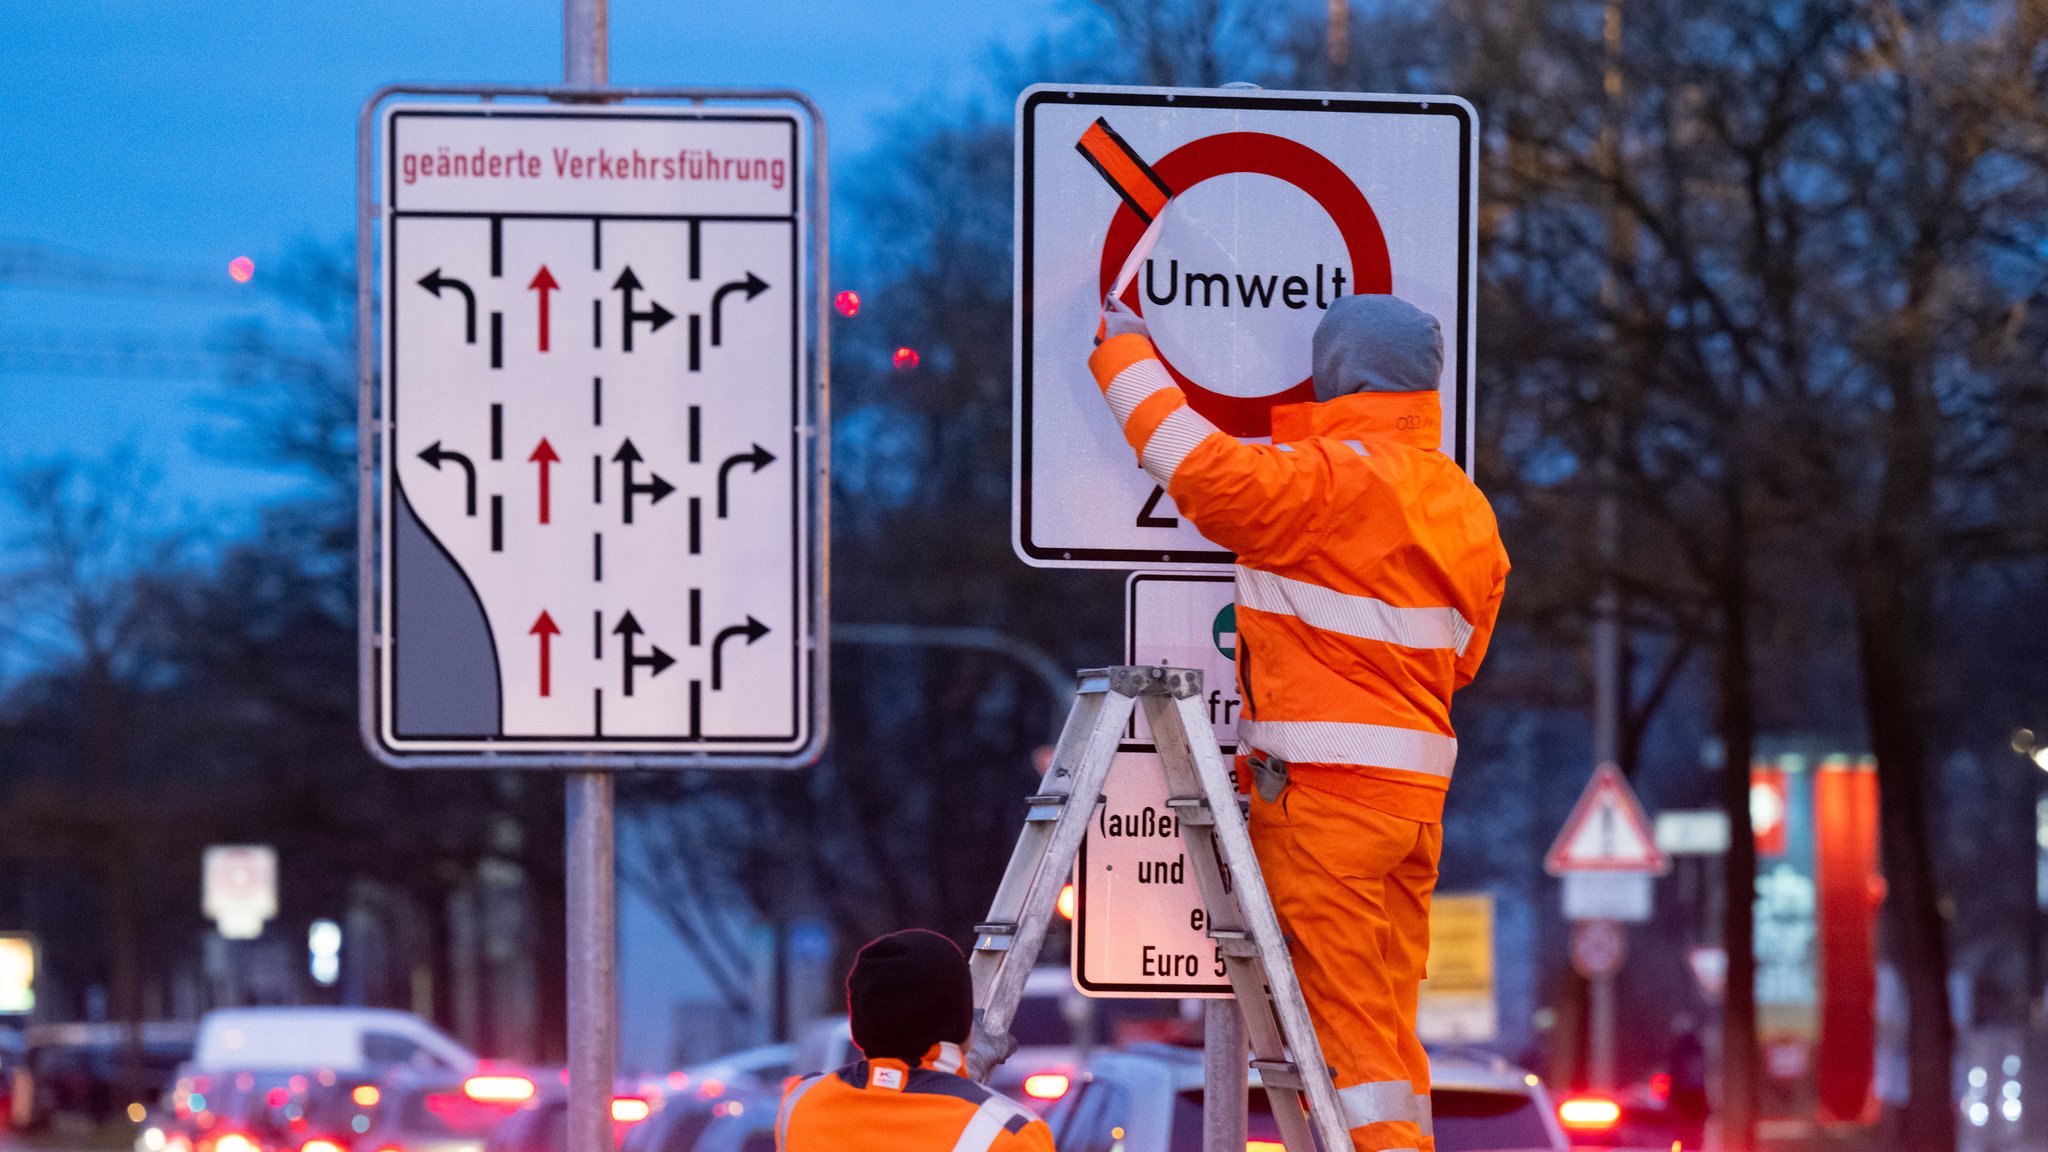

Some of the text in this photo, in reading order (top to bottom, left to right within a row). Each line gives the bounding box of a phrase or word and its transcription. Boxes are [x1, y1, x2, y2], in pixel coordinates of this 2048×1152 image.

[402, 146, 786, 190] geänderte Verkehrsführung
[1146, 259, 1347, 310] Umwelt
[1208, 689, 1241, 725] fr
[1138, 853, 1184, 884] und
[1142, 945, 1199, 978] Euro
